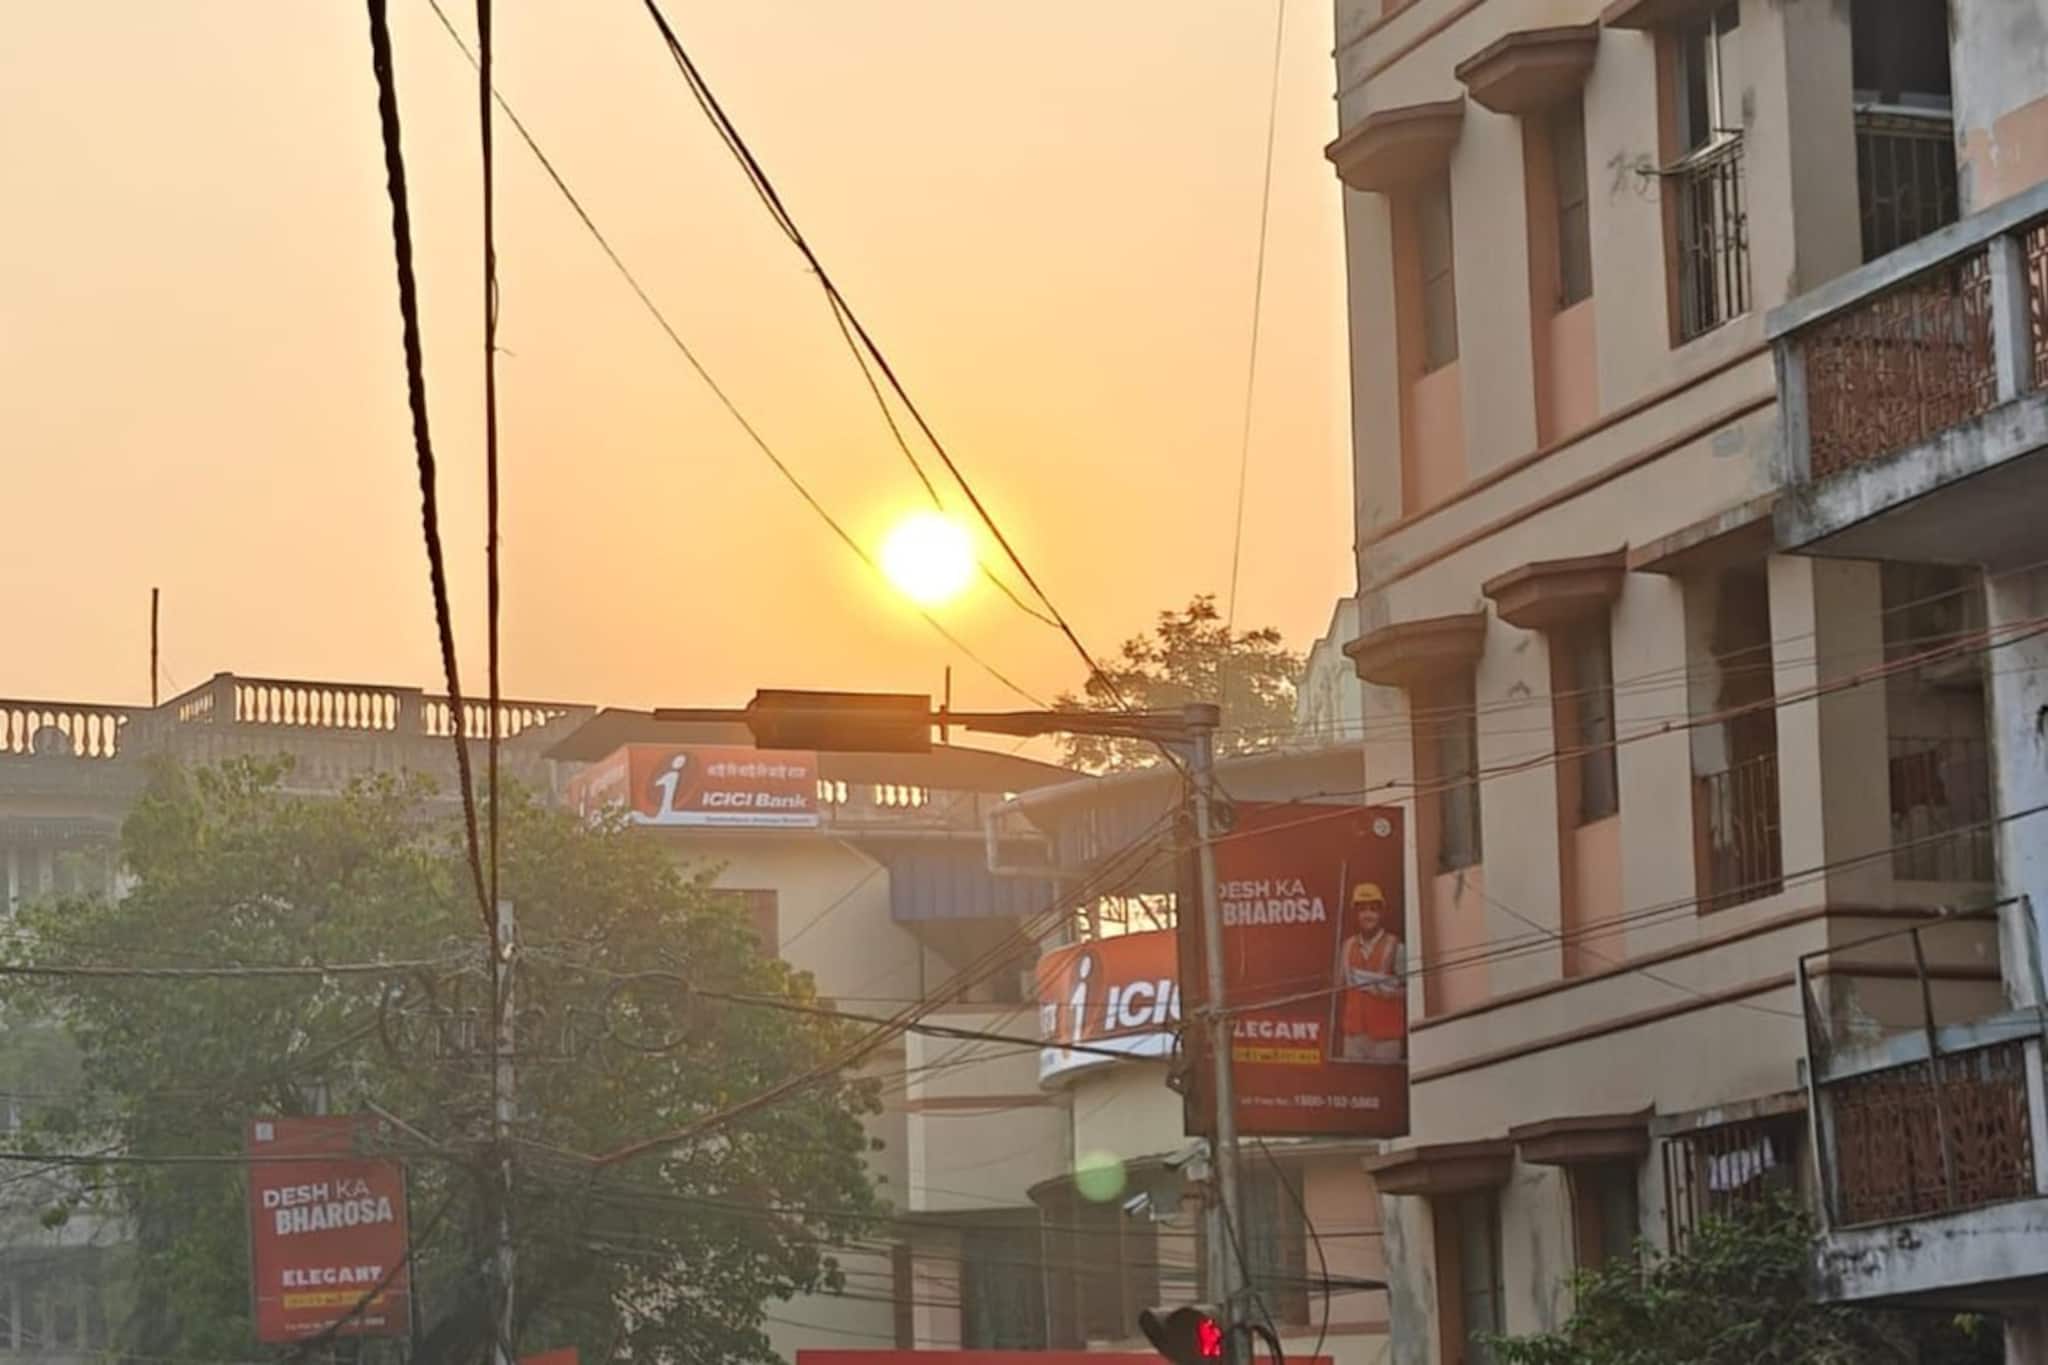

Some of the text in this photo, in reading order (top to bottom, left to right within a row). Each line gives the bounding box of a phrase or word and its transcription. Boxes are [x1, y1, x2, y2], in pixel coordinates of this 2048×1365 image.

[702, 791, 808, 808] ICICI Bank
[1276, 879, 1306, 896] KA
[1223, 897, 1326, 926] BHAROSA
[1104, 979, 1181, 1031] ICI
[1232, 1020, 1320, 1040] LEGANT
[263, 1179, 370, 1208] DESH KA
[275, 1197, 393, 1235] BHAROSA
[282, 1265, 383, 1287] ELEGANT
